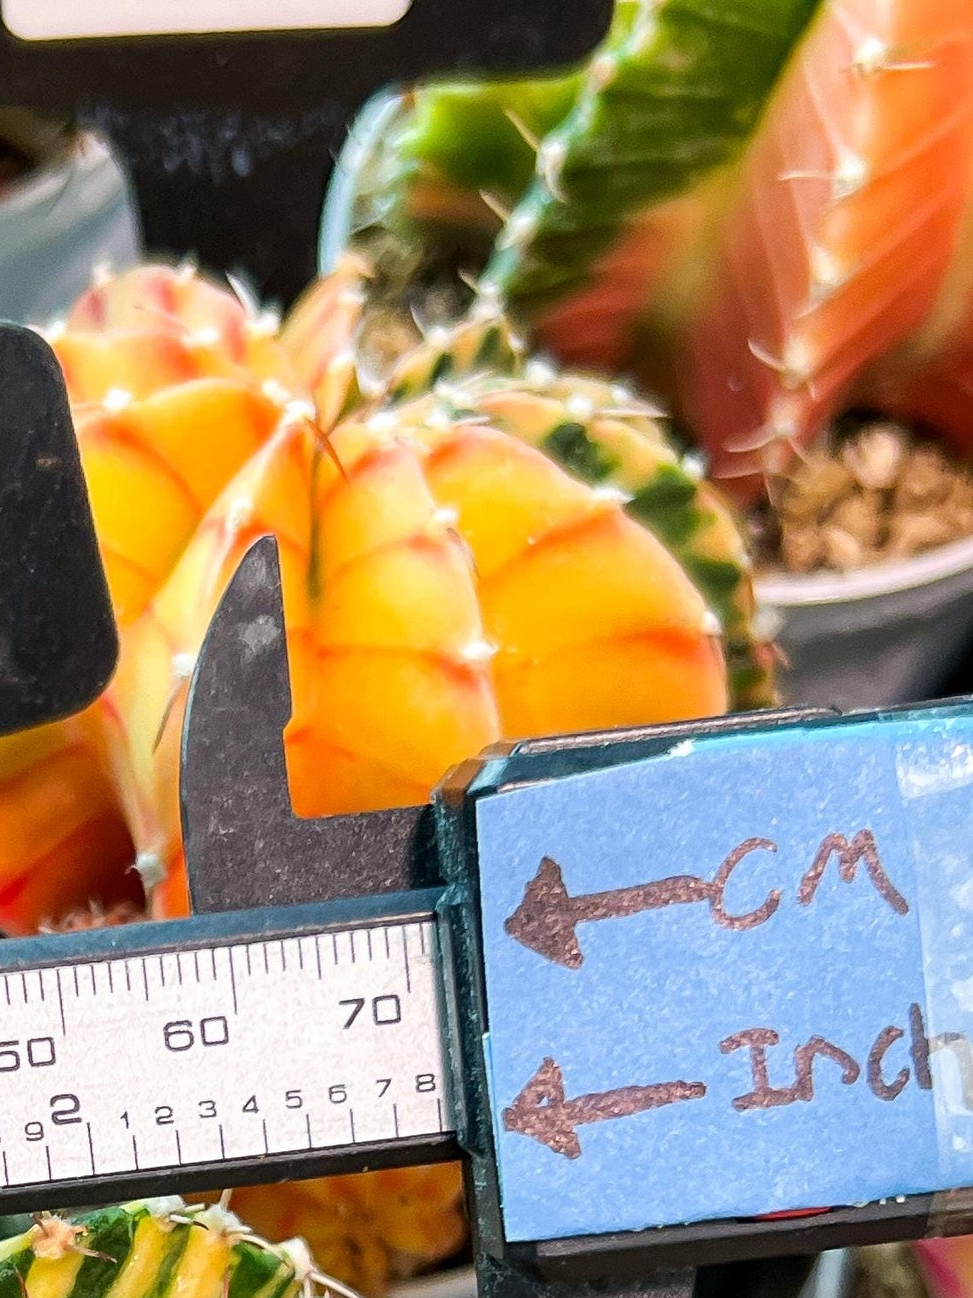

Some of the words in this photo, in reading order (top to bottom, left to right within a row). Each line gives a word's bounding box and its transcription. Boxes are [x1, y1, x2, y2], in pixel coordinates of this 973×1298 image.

[162, 1015, 230, 1053] 60
[338, 994, 402, 1030] 70
[24, 1121, 45, 1142] 9
[49, 1093, 83, 1126] 2
[120, 1110, 130, 1130] 1
[154, 1105, 175, 1126] 2
[197, 1099, 218, 1119] 3
[241, 1094, 260, 1114] 4
[285, 1089, 303, 1110] 5
[328, 1083, 348, 1105] 6
[375, 1078, 392, 1098] 7
[415, 1073, 437, 1094] 8
